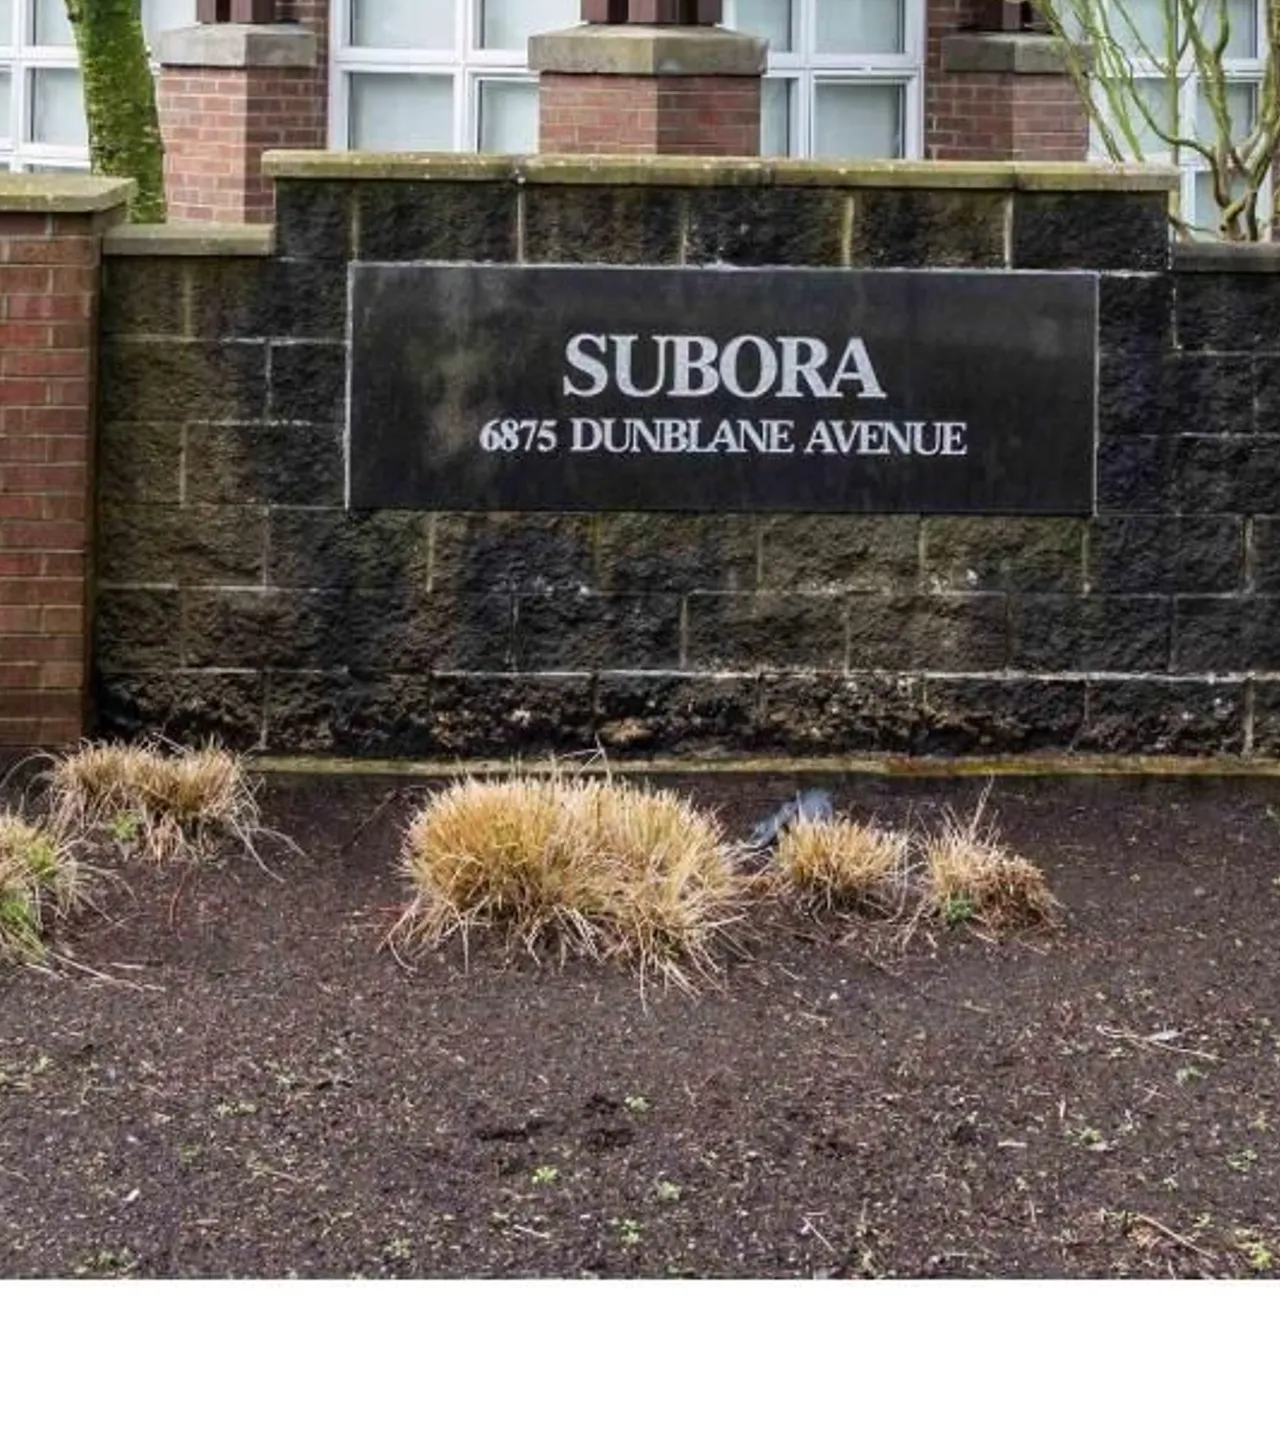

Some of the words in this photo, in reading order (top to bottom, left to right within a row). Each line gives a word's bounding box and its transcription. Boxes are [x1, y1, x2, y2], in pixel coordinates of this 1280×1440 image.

[563, 333, 887, 399] SUBORA
[479, 419, 557, 452] 6875
[570, 417, 795, 453] DUNBLANE
[804, 420, 968, 456] AVENUE
